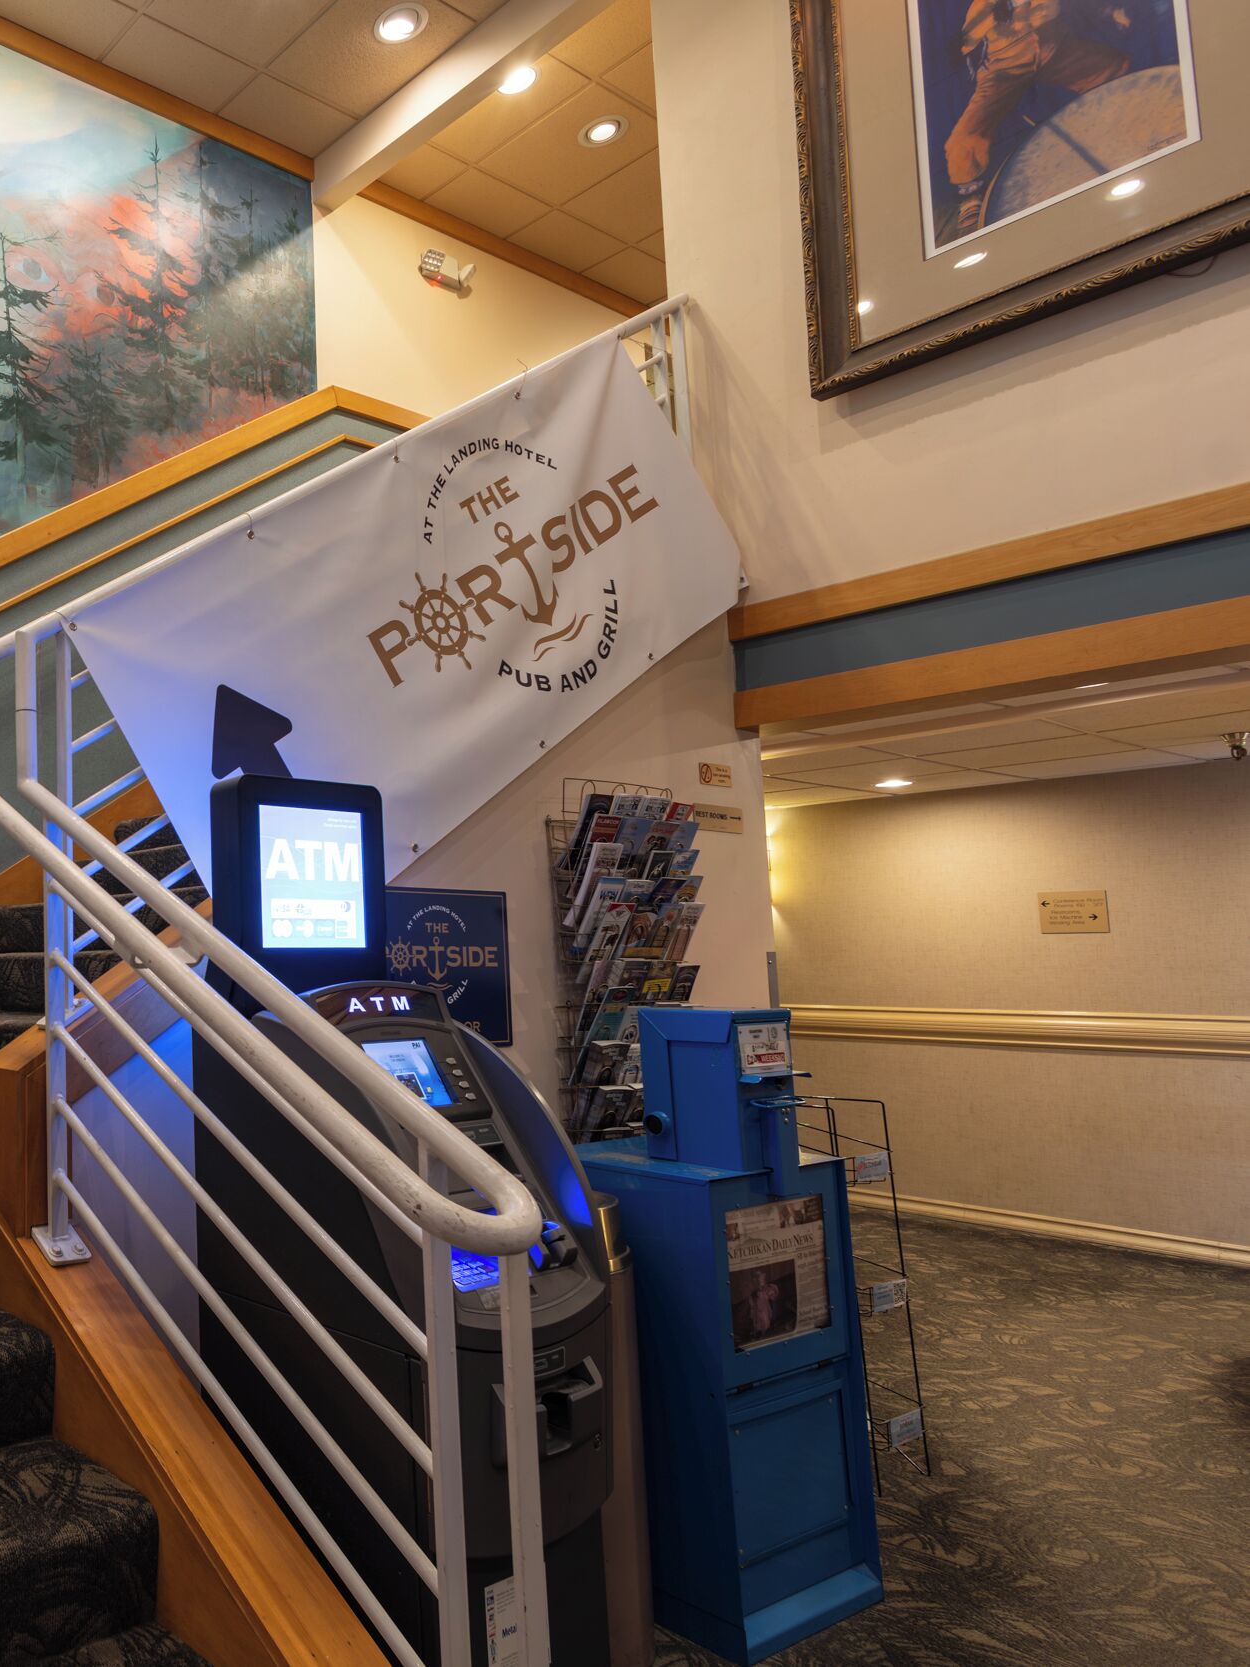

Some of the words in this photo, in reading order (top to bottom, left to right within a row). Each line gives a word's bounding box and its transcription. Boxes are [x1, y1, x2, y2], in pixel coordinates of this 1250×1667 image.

[443, 437, 500, 477] LANDING
[504, 439, 558, 470] HOTEL
[427, 473, 447, 511] THE
[458, 475, 521, 524] THE
[422, 517, 434, 544] AT
[365, 463, 661, 689] PORTSIDE
[497, 659, 552, 692] PUB
[560, 658, 598, 693] AND
[597, 578, 618, 660] GRILL
[265, 838, 361, 883] ATM
[406, 920, 414, 931] AT
[412, 909, 424, 921] THE
[424, 904, 450, 915] LANDING
[450, 911, 467, 932] HOTEL
[425, 922, 450, 934] THE
[385, 937, 499, 981] ORTSIDE
[348, 996, 411, 1013] ATM
[447, 979, 469, 1005] GRILL
[771, 1237, 794, 1251] DAILY
